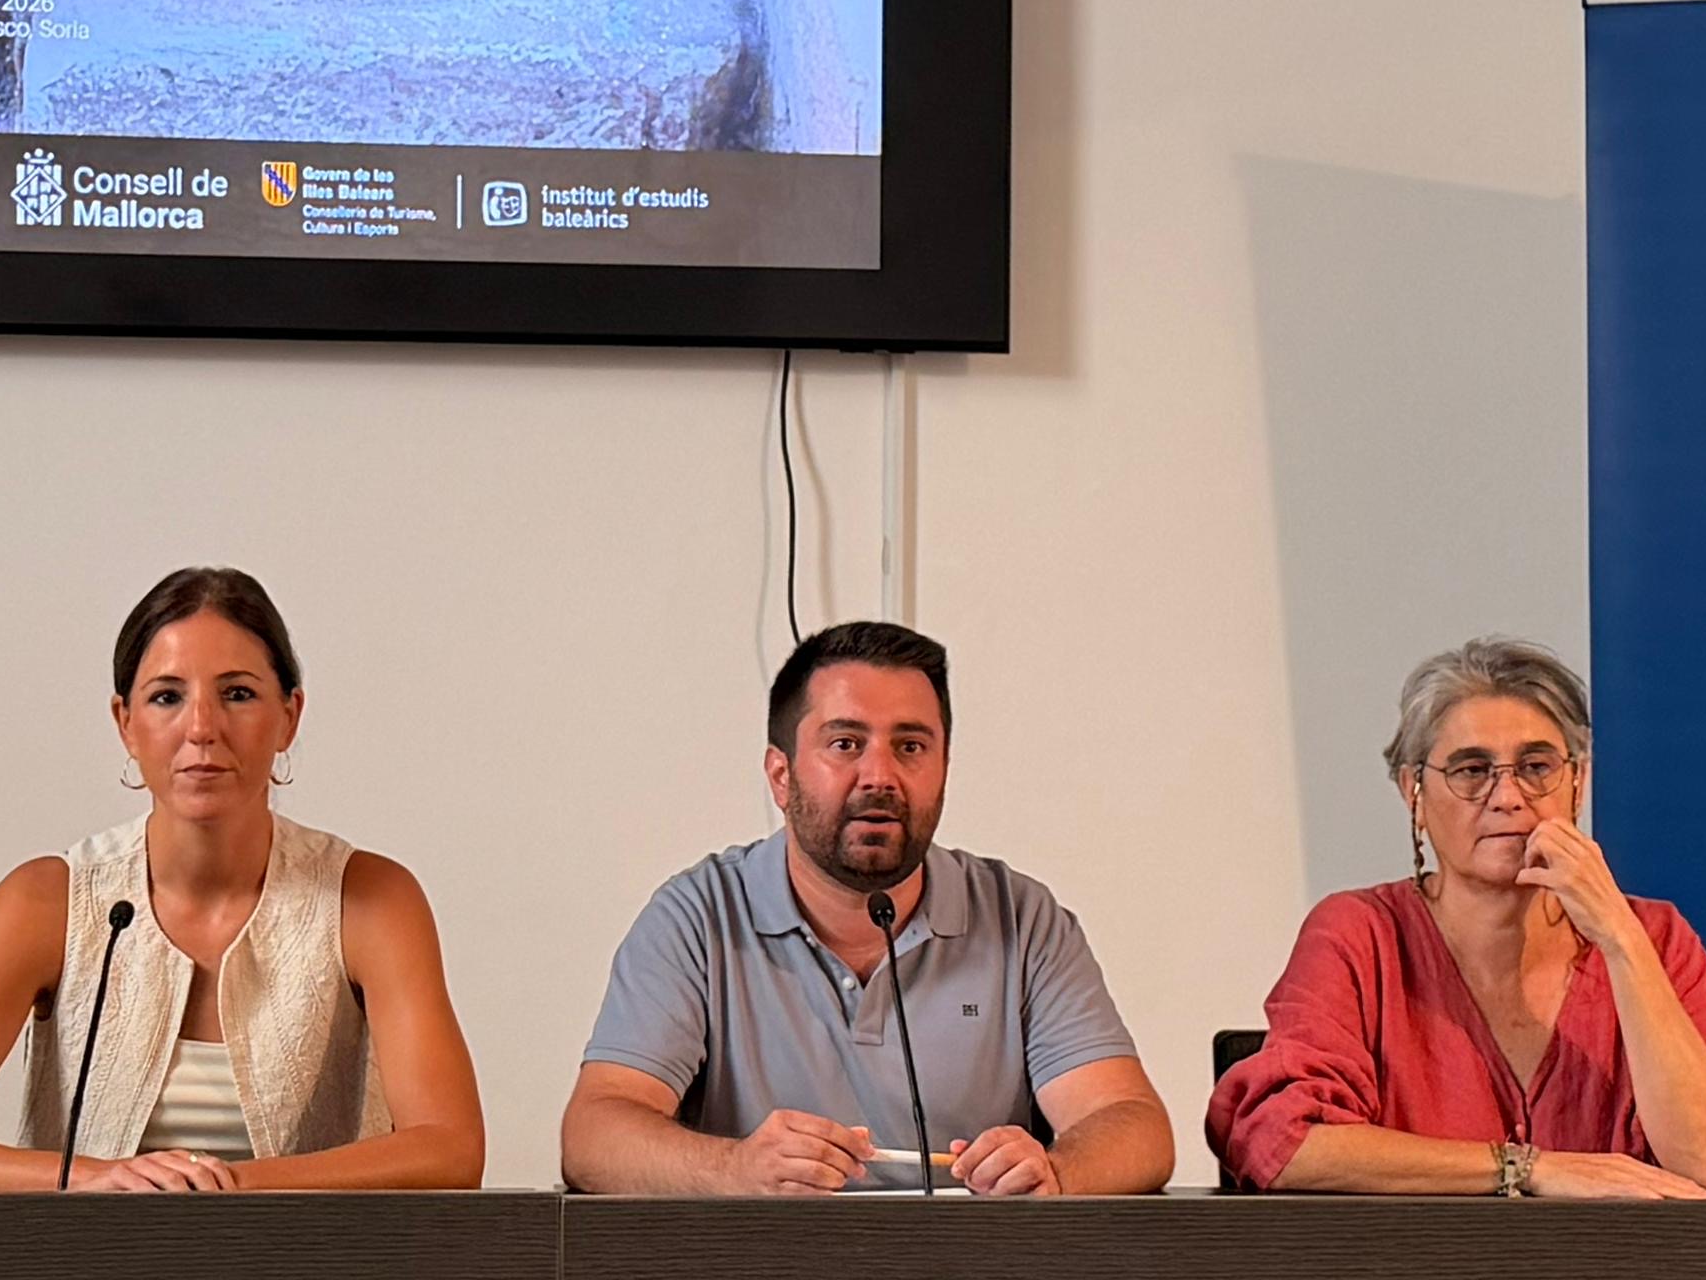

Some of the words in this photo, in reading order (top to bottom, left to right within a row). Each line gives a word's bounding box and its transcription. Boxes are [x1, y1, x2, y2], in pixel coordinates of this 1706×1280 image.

[39, 20, 90, 39] Soria
[73, 166, 182, 197] Consell
[192, 169, 229, 198] de
[541, 185, 616, 206] institut
[73, 199, 204, 229] Mallorca
[542, 207, 629, 228] baleàrics
